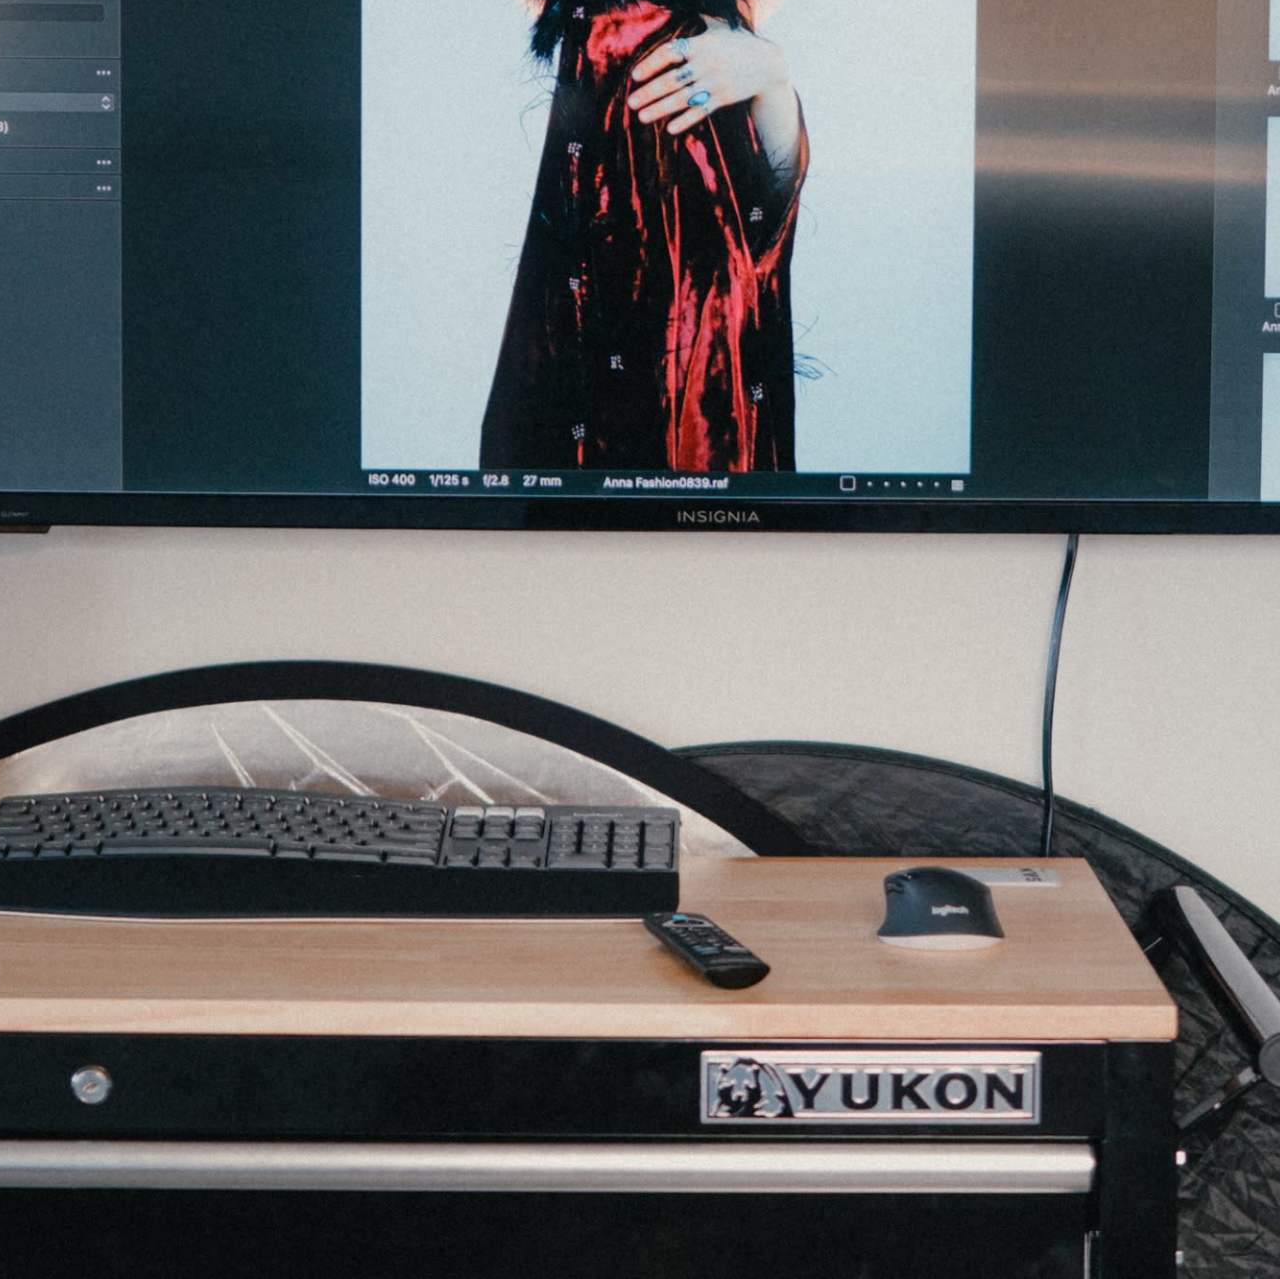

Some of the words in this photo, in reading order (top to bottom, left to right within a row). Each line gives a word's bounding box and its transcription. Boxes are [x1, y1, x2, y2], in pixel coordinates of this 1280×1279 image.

[368, 473, 389, 486] ISO
[391, 473, 416, 486] 400
[429, 474, 460, 487] 1/125
[461, 477, 469, 486] s
[482, 474, 510, 487] f/2.8
[522, 475, 537, 487] 27
[540, 477, 563, 487] mm
[603, 476, 633, 489] Anna
[635, 476, 729, 489] Fashion0839.raf
[677, 510, 761, 523] INSIGNIA
[931, 904, 969, 917] logitech
[786, 1067, 1026, 1111] YUKON
